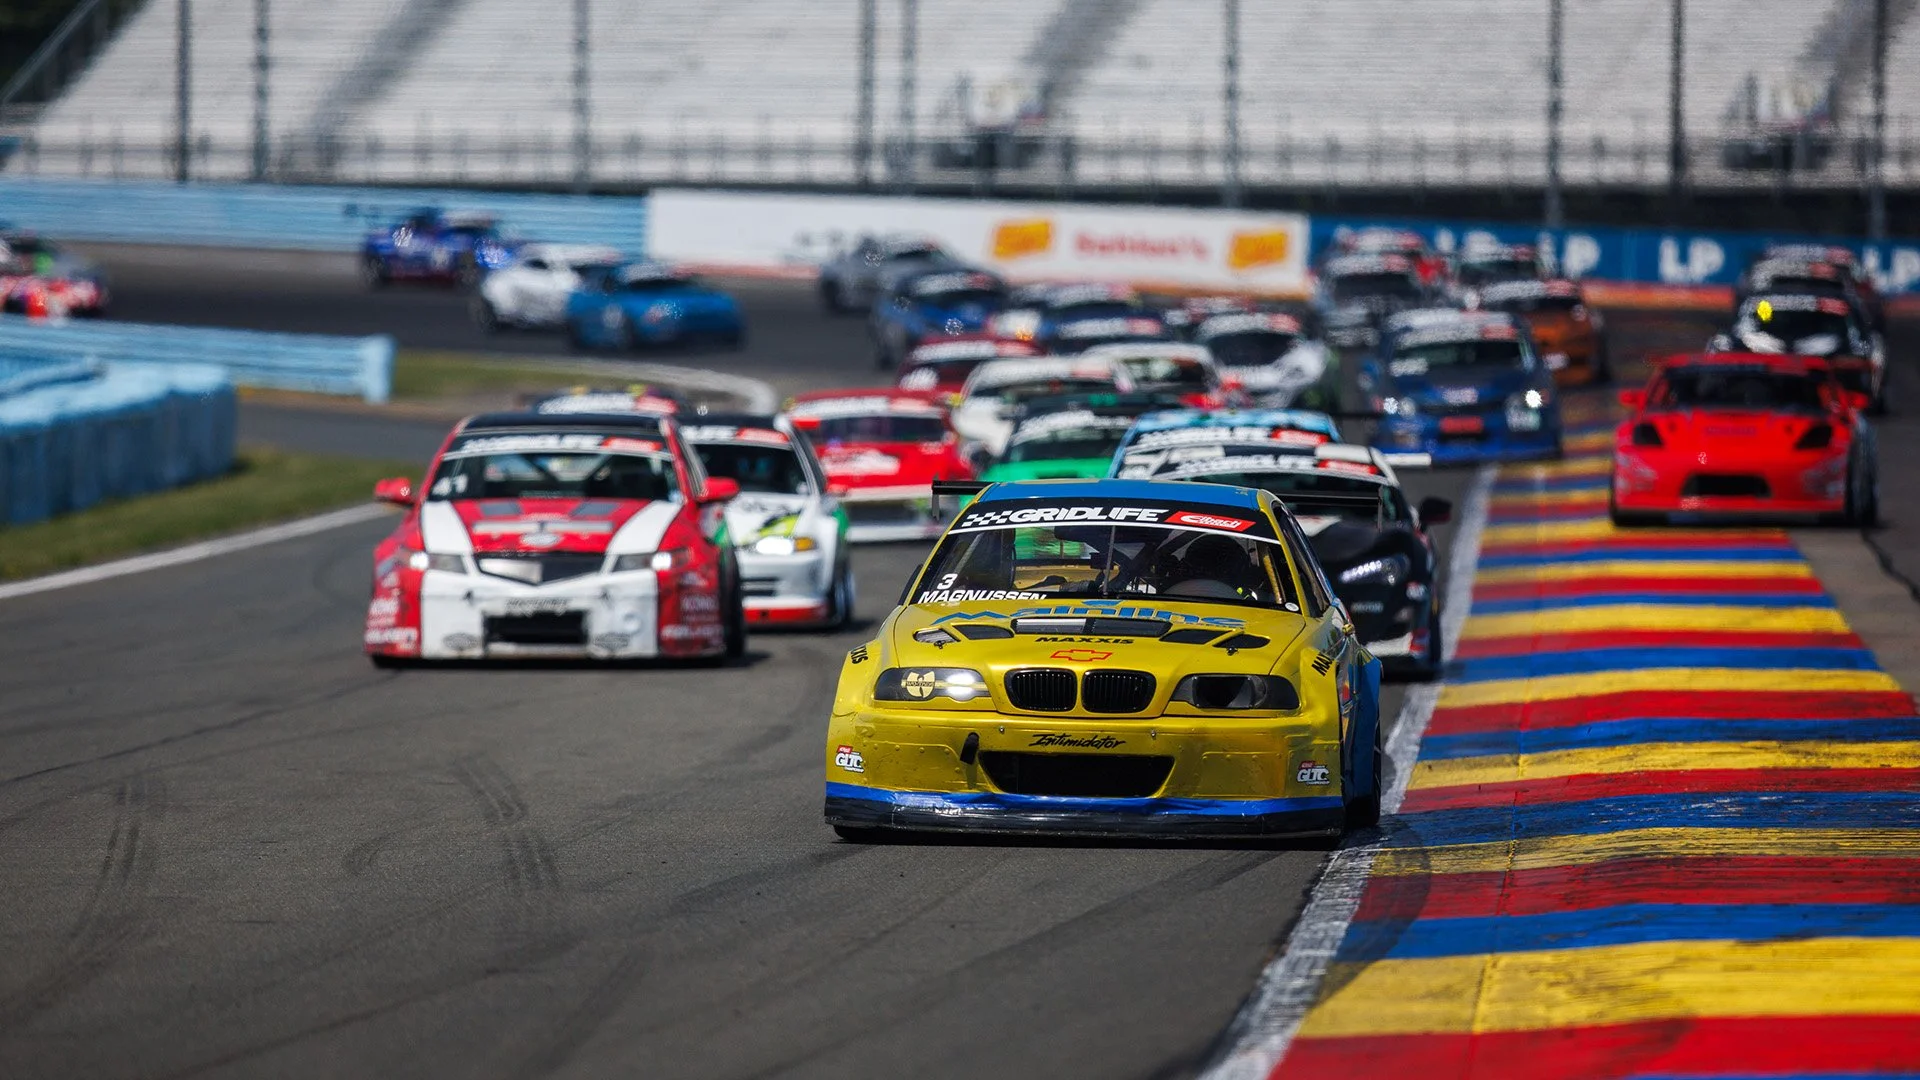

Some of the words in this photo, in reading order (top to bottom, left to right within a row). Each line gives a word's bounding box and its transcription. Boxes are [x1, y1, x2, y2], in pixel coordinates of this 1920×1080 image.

[1659, 236, 1724, 284] LP
[1009, 507, 1168, 523] GRIDLIFE
[937, 573, 958, 590] 3
[918, 590, 1047, 604] MAGNUSSEN
[1035, 636, 1135, 645] MAXXIS
[1029, 733, 1126, 749] Intimidator
[835, 752, 864, 768] GLTC
[1296, 769, 1330, 783] GLTC
